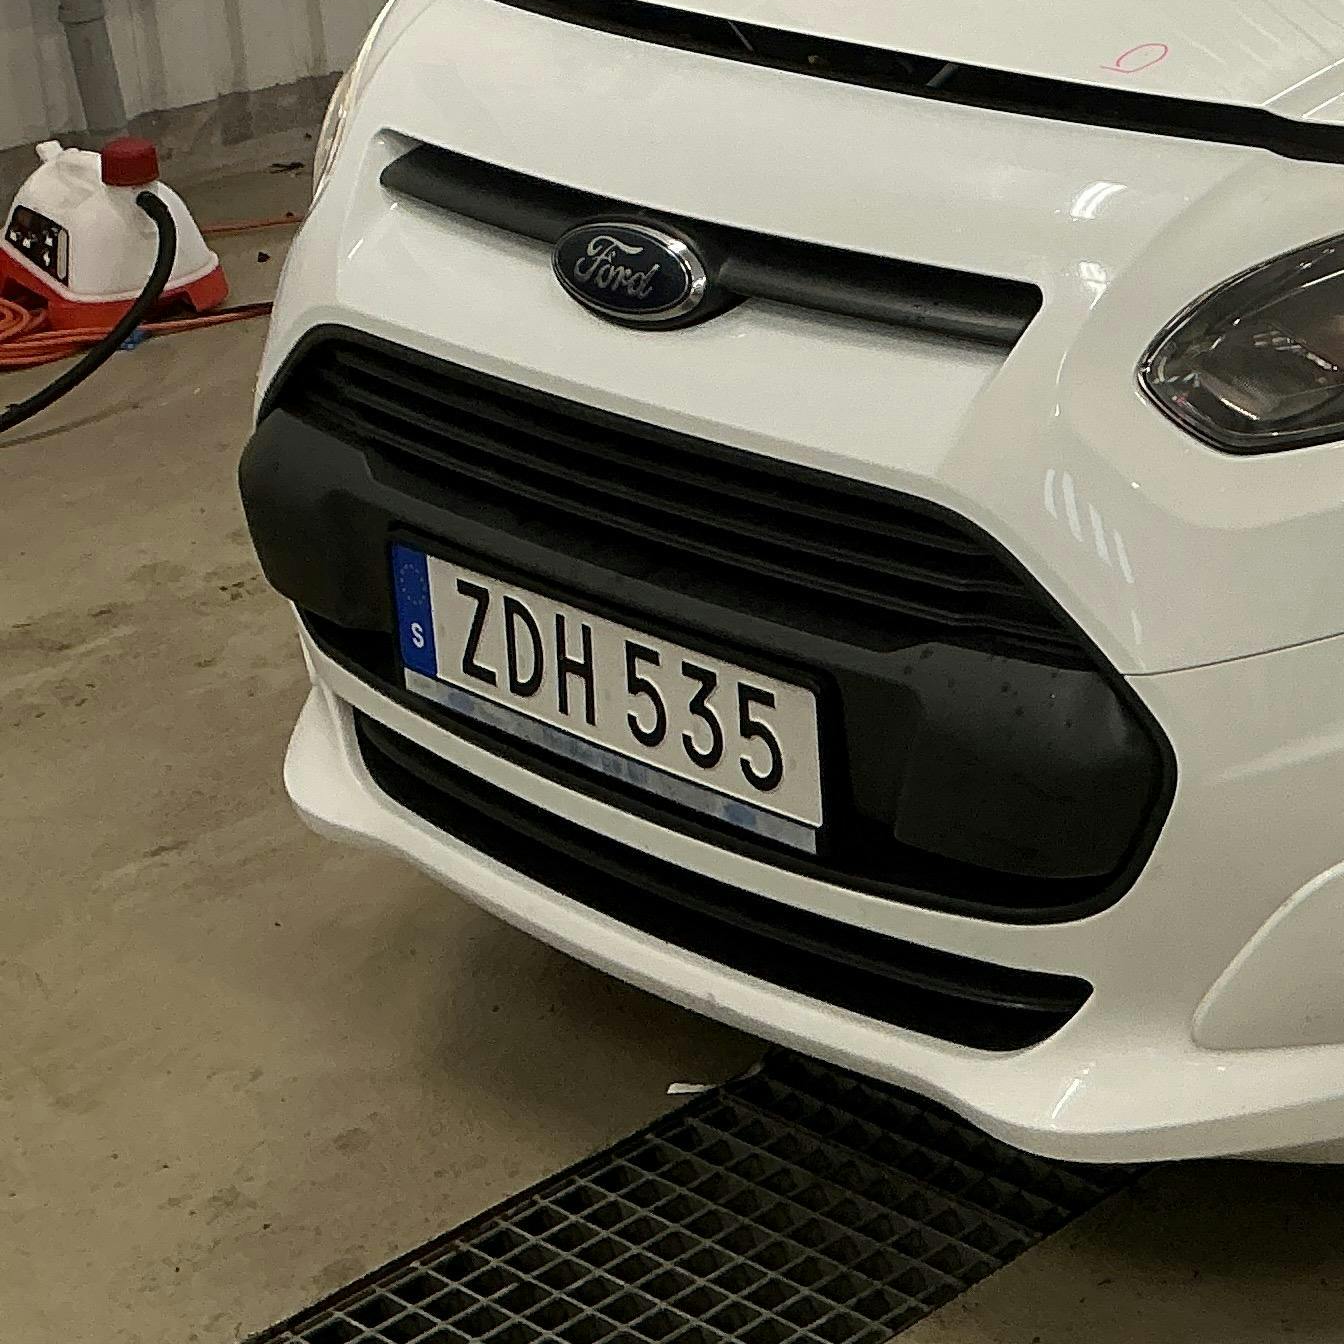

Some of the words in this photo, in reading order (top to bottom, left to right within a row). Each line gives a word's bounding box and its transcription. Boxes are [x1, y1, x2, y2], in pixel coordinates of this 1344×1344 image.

[574, 235, 661, 299] Ford
[411, 622, 425, 649] S
[456, 578, 597, 726] ZDH
[625, 640, 783, 792] 535
